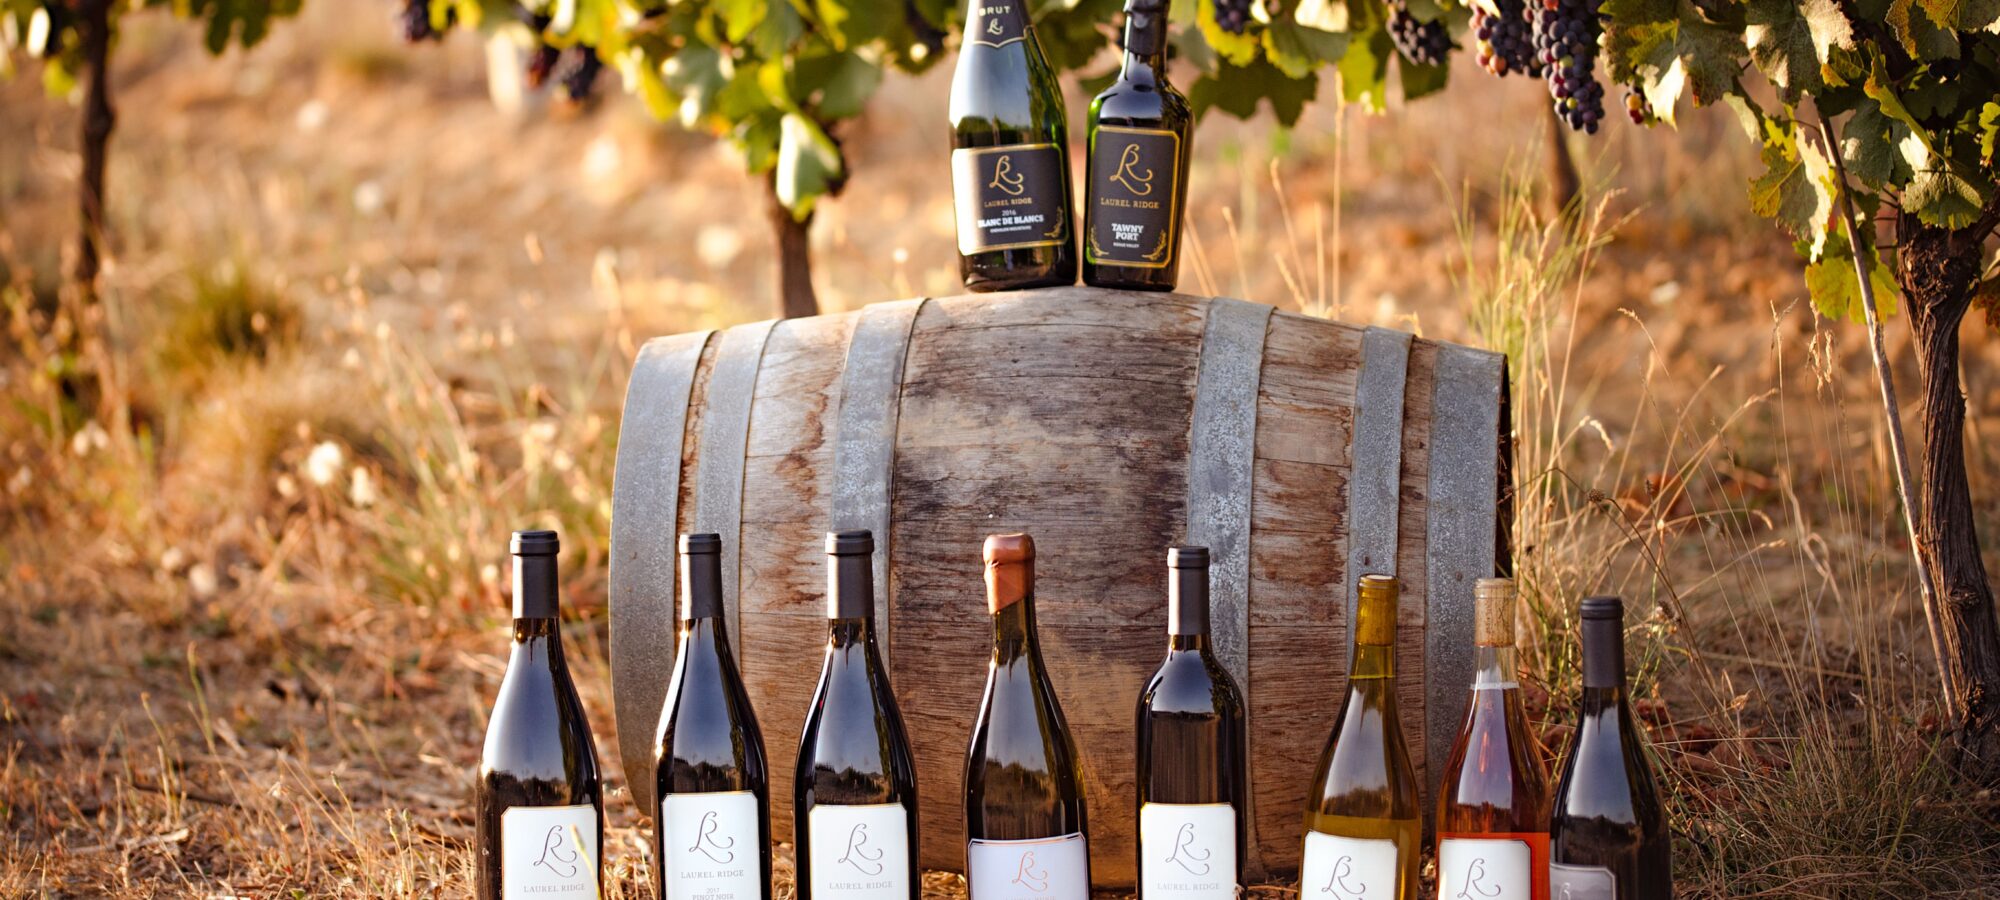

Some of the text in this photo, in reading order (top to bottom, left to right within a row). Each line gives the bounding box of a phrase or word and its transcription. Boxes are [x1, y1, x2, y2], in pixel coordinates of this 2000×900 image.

[984, 197, 1032, 208] LAUREL RIDGE
[1101, 197, 1160, 209] LAUREL RIDGE
[1002, 217, 1013, 225] DE
[1014, 214, 1044, 224] BLANCS
[1111, 223, 1144, 233] TAWNY
[1115, 231, 1139, 241] PORT
[680, 869, 744, 880] LAUREL RIDGE
[523, 882, 585, 893] LAUREL RIDGE
[829, 880, 893, 891] LAUREL RIDGE
[1157, 882, 1220, 891] LAUREL RIDGE
